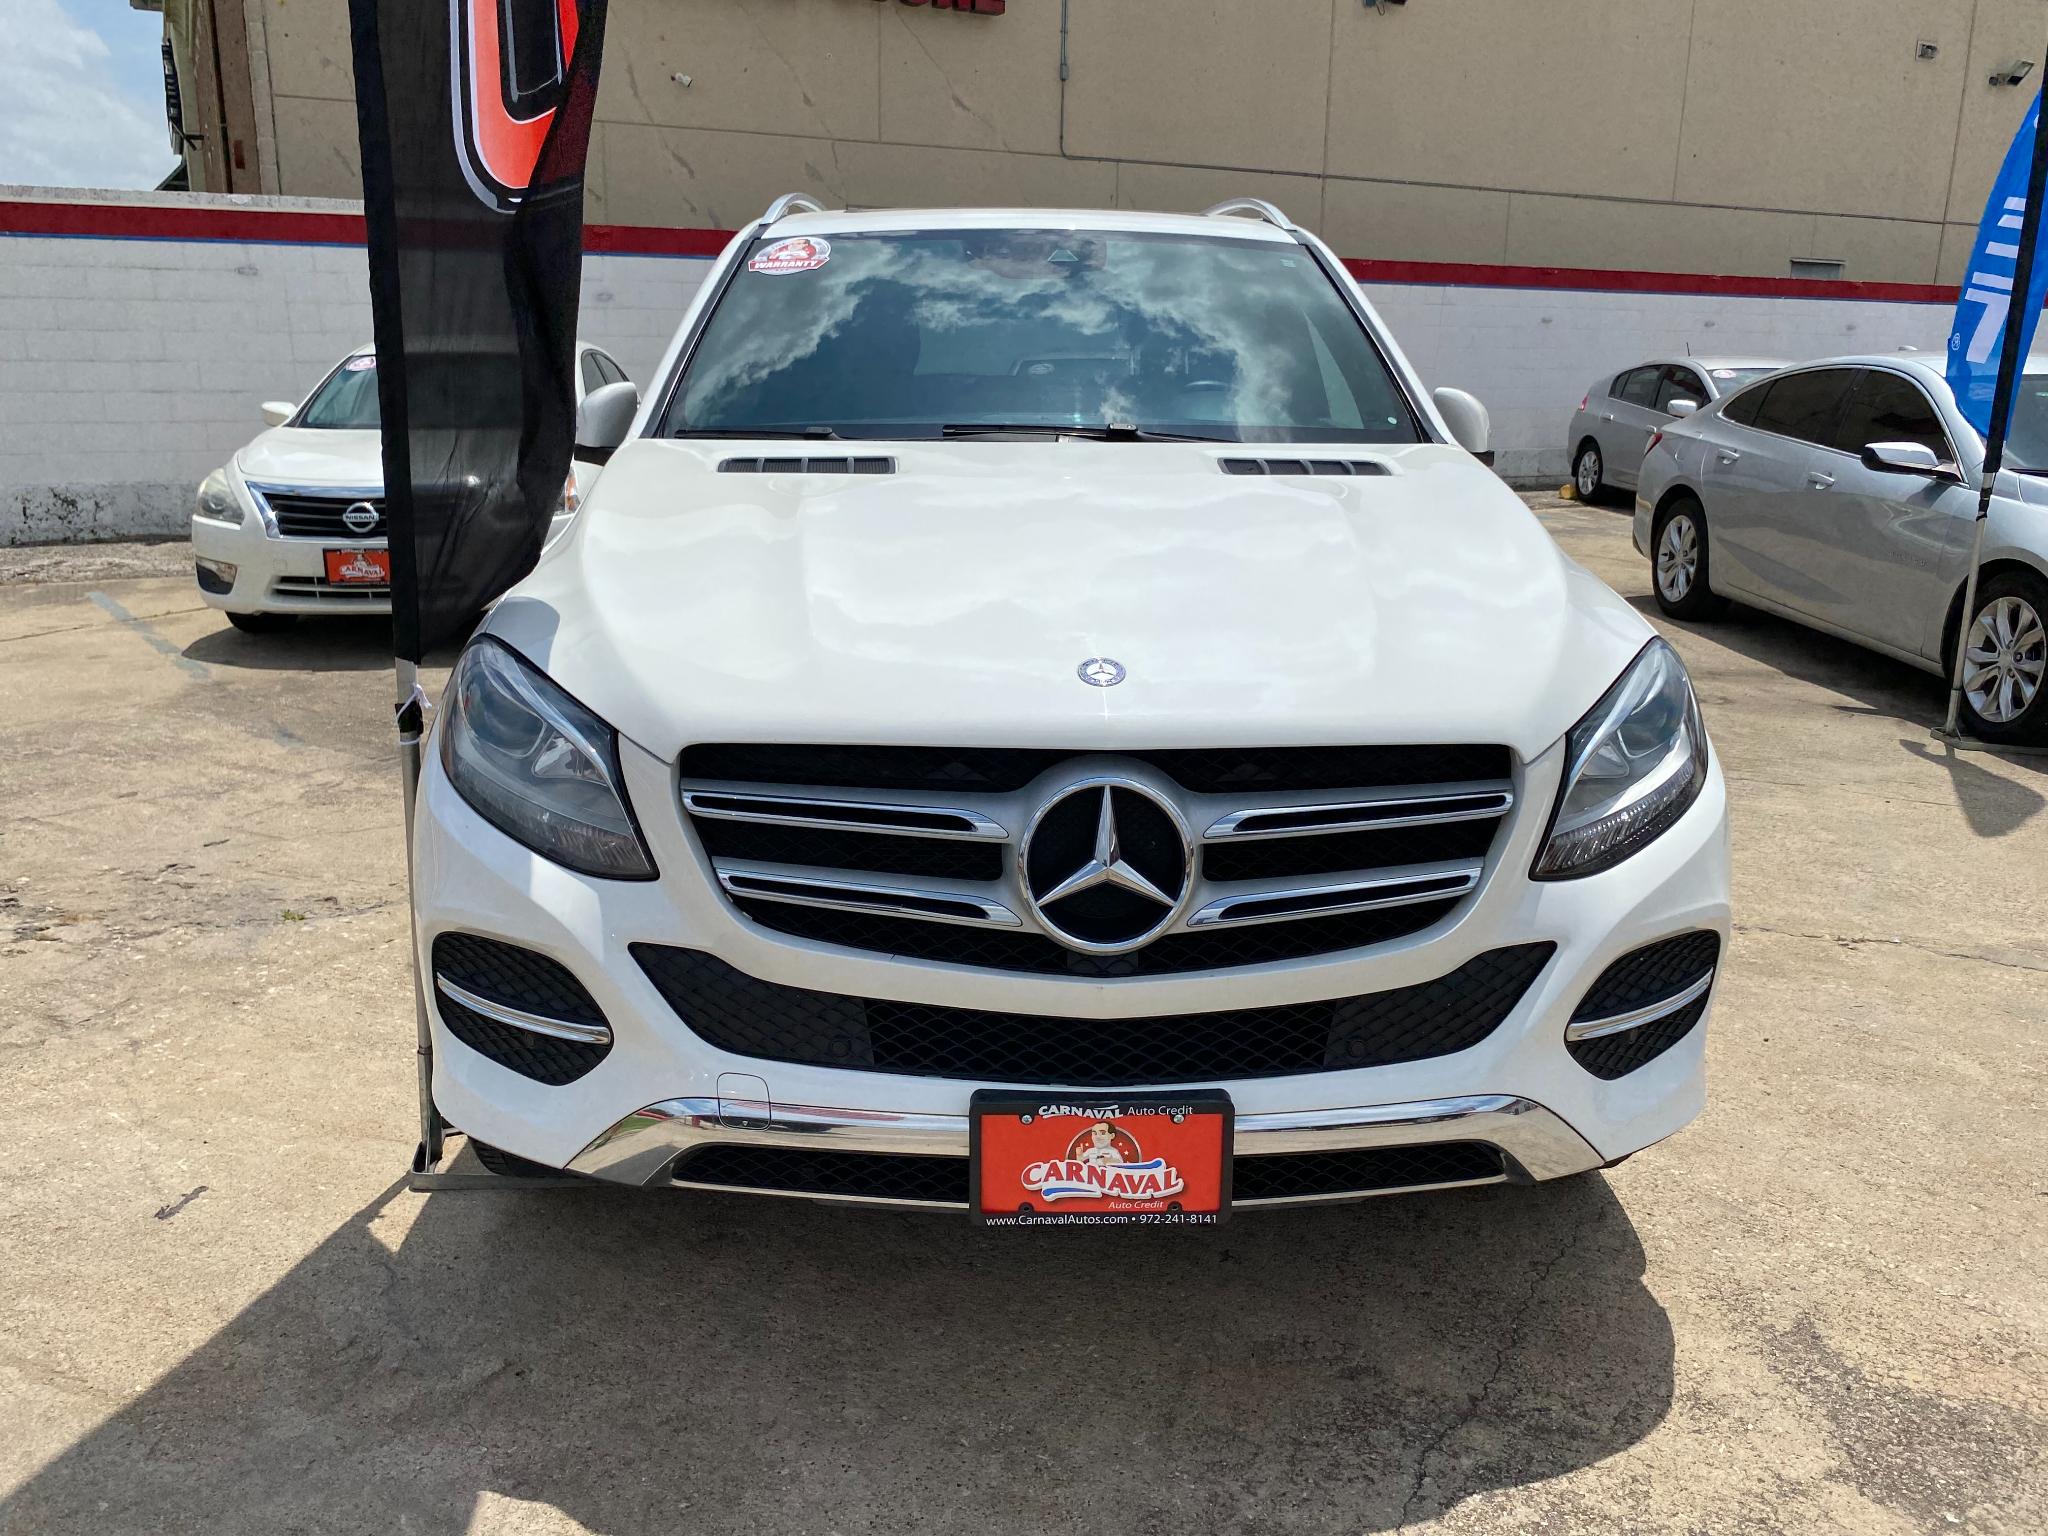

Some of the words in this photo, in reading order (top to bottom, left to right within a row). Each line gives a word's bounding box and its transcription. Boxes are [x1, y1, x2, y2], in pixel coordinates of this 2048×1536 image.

[754, 260, 818, 269] WARRANTY
[1038, 1104, 1123, 1119] CARNAVAL
[1127, 1106, 1155, 1116] Auto
[1158, 1105, 1193, 1115] Credit
[1021, 1159, 1182, 1198] CARNAVAL
[1108, 1201, 1132, 1209] Auto
[1134, 1200, 1164, 1209] Credit
[985, 1214, 1128, 1226] www.CarnavalAutos.com
[1139, 1213, 1217, 1224] 972-241-8141
